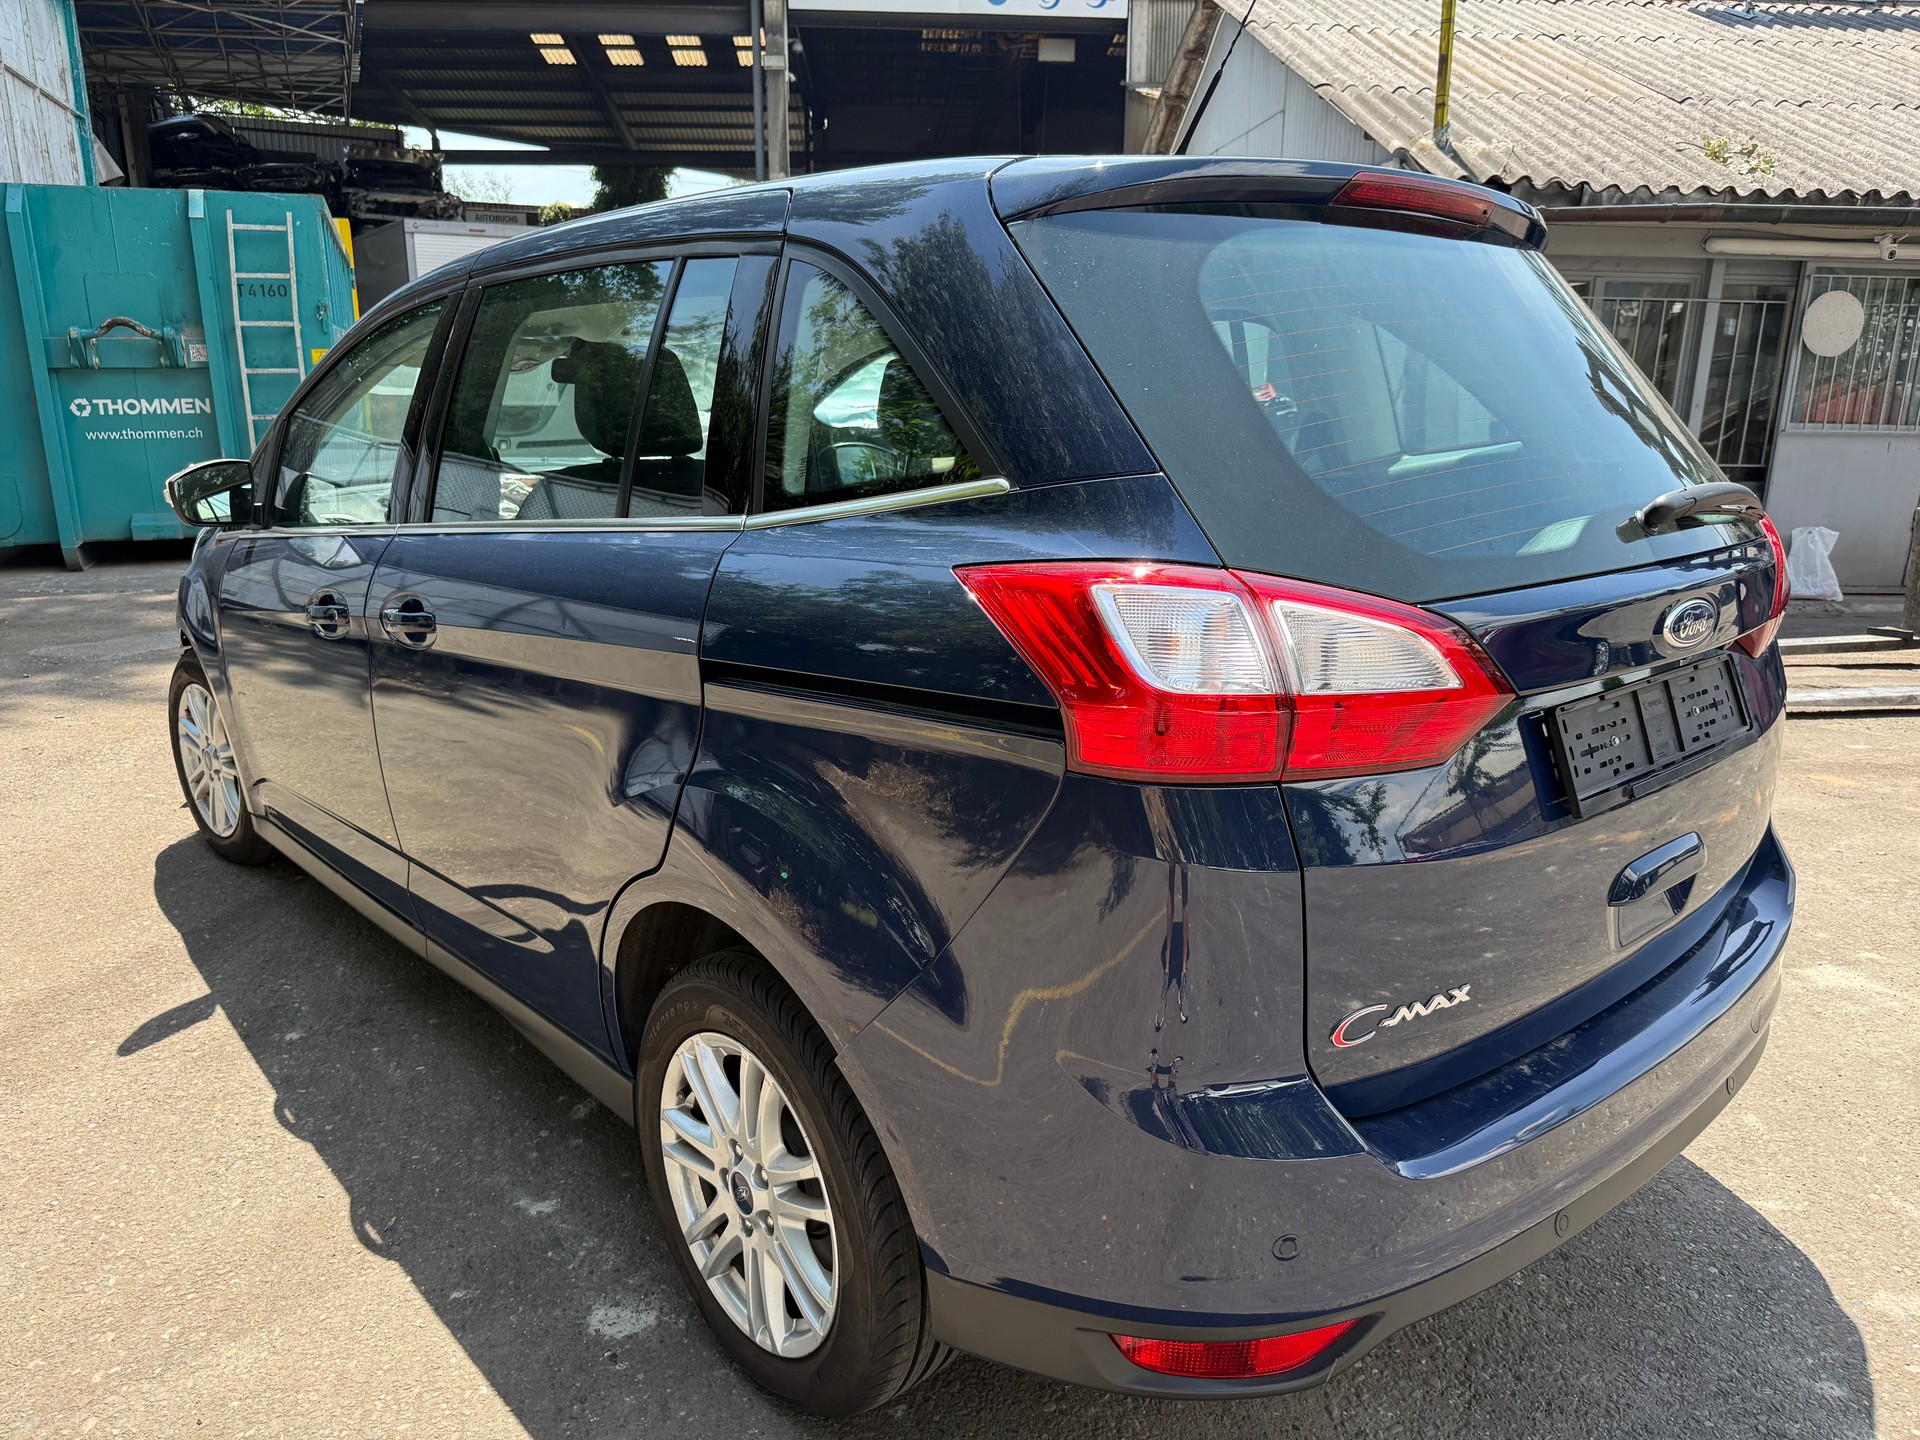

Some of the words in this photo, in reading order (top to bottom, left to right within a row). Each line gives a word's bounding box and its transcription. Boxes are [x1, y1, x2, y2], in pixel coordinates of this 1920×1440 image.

[92, 397, 212, 416] THOMMEN
[85, 426, 204, 440] www.thommen.ch
[1680, 608, 1709, 639] Ford
